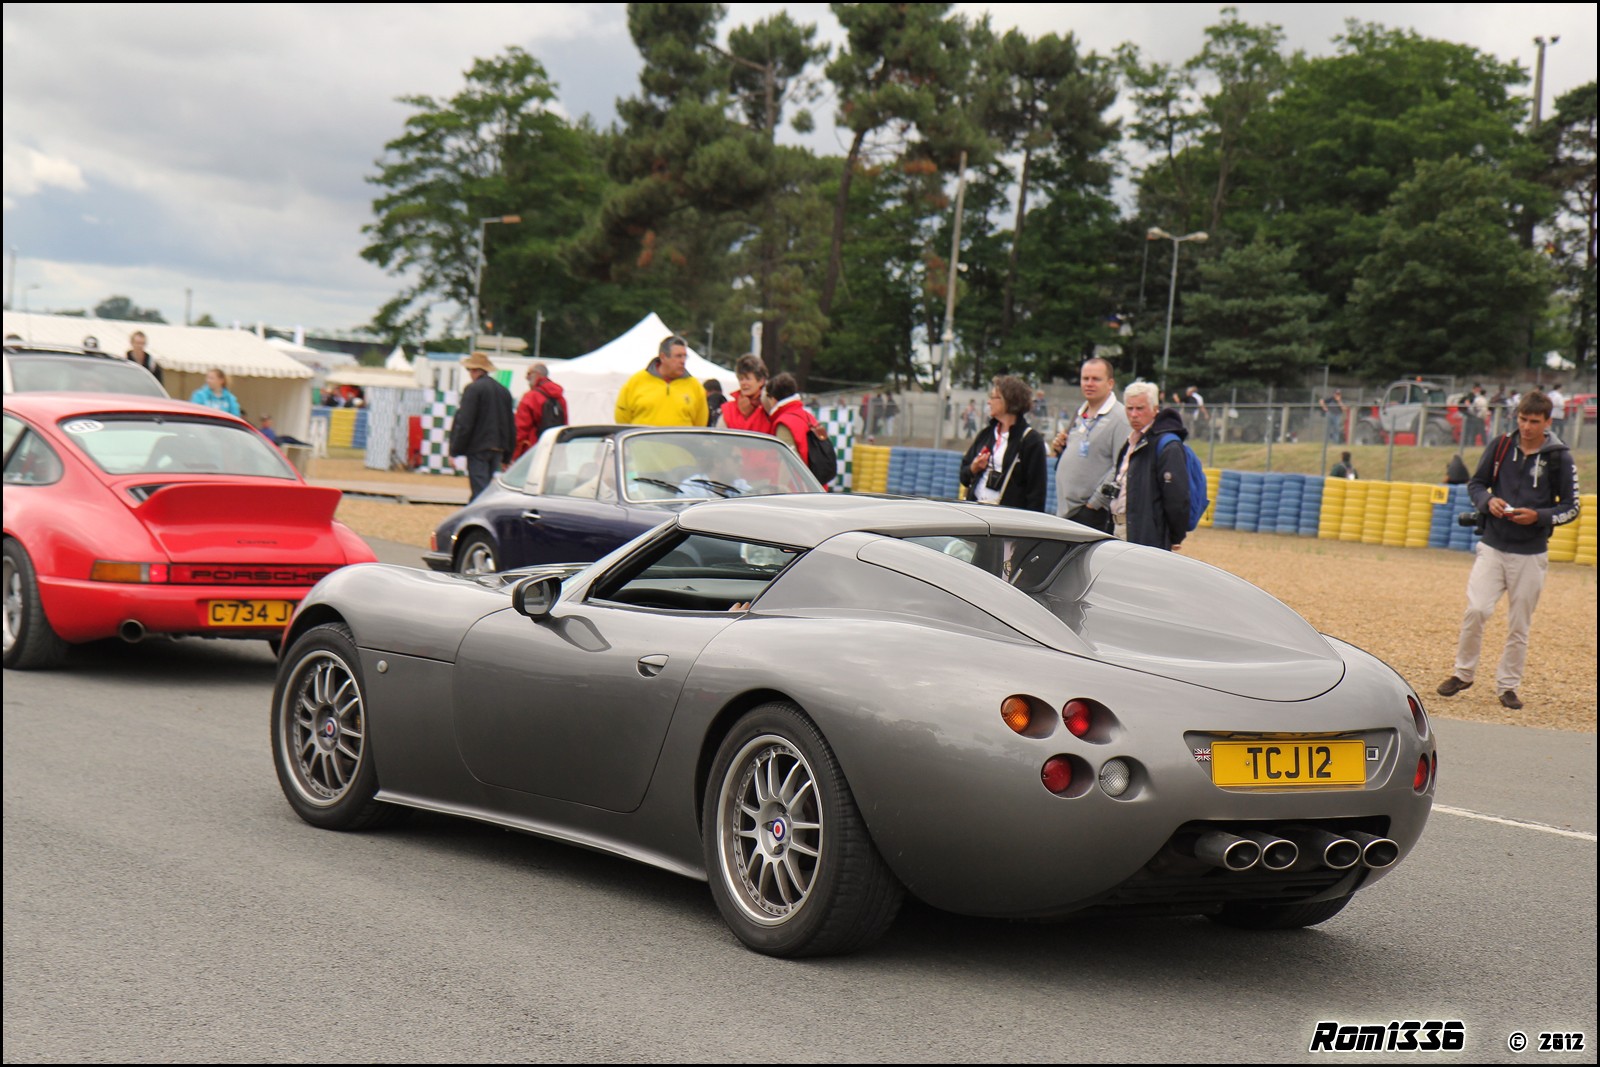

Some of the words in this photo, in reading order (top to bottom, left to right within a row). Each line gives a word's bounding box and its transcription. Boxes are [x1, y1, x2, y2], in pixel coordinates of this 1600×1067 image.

[68, 422, 99, 432] GB
[191, 570, 328, 581] PORSCHE
[212, 603, 269, 623] C734
[275, 603, 288, 623] J
[1246, 746, 1300, 780] TCJ
[1307, 746, 1332, 779] 12
